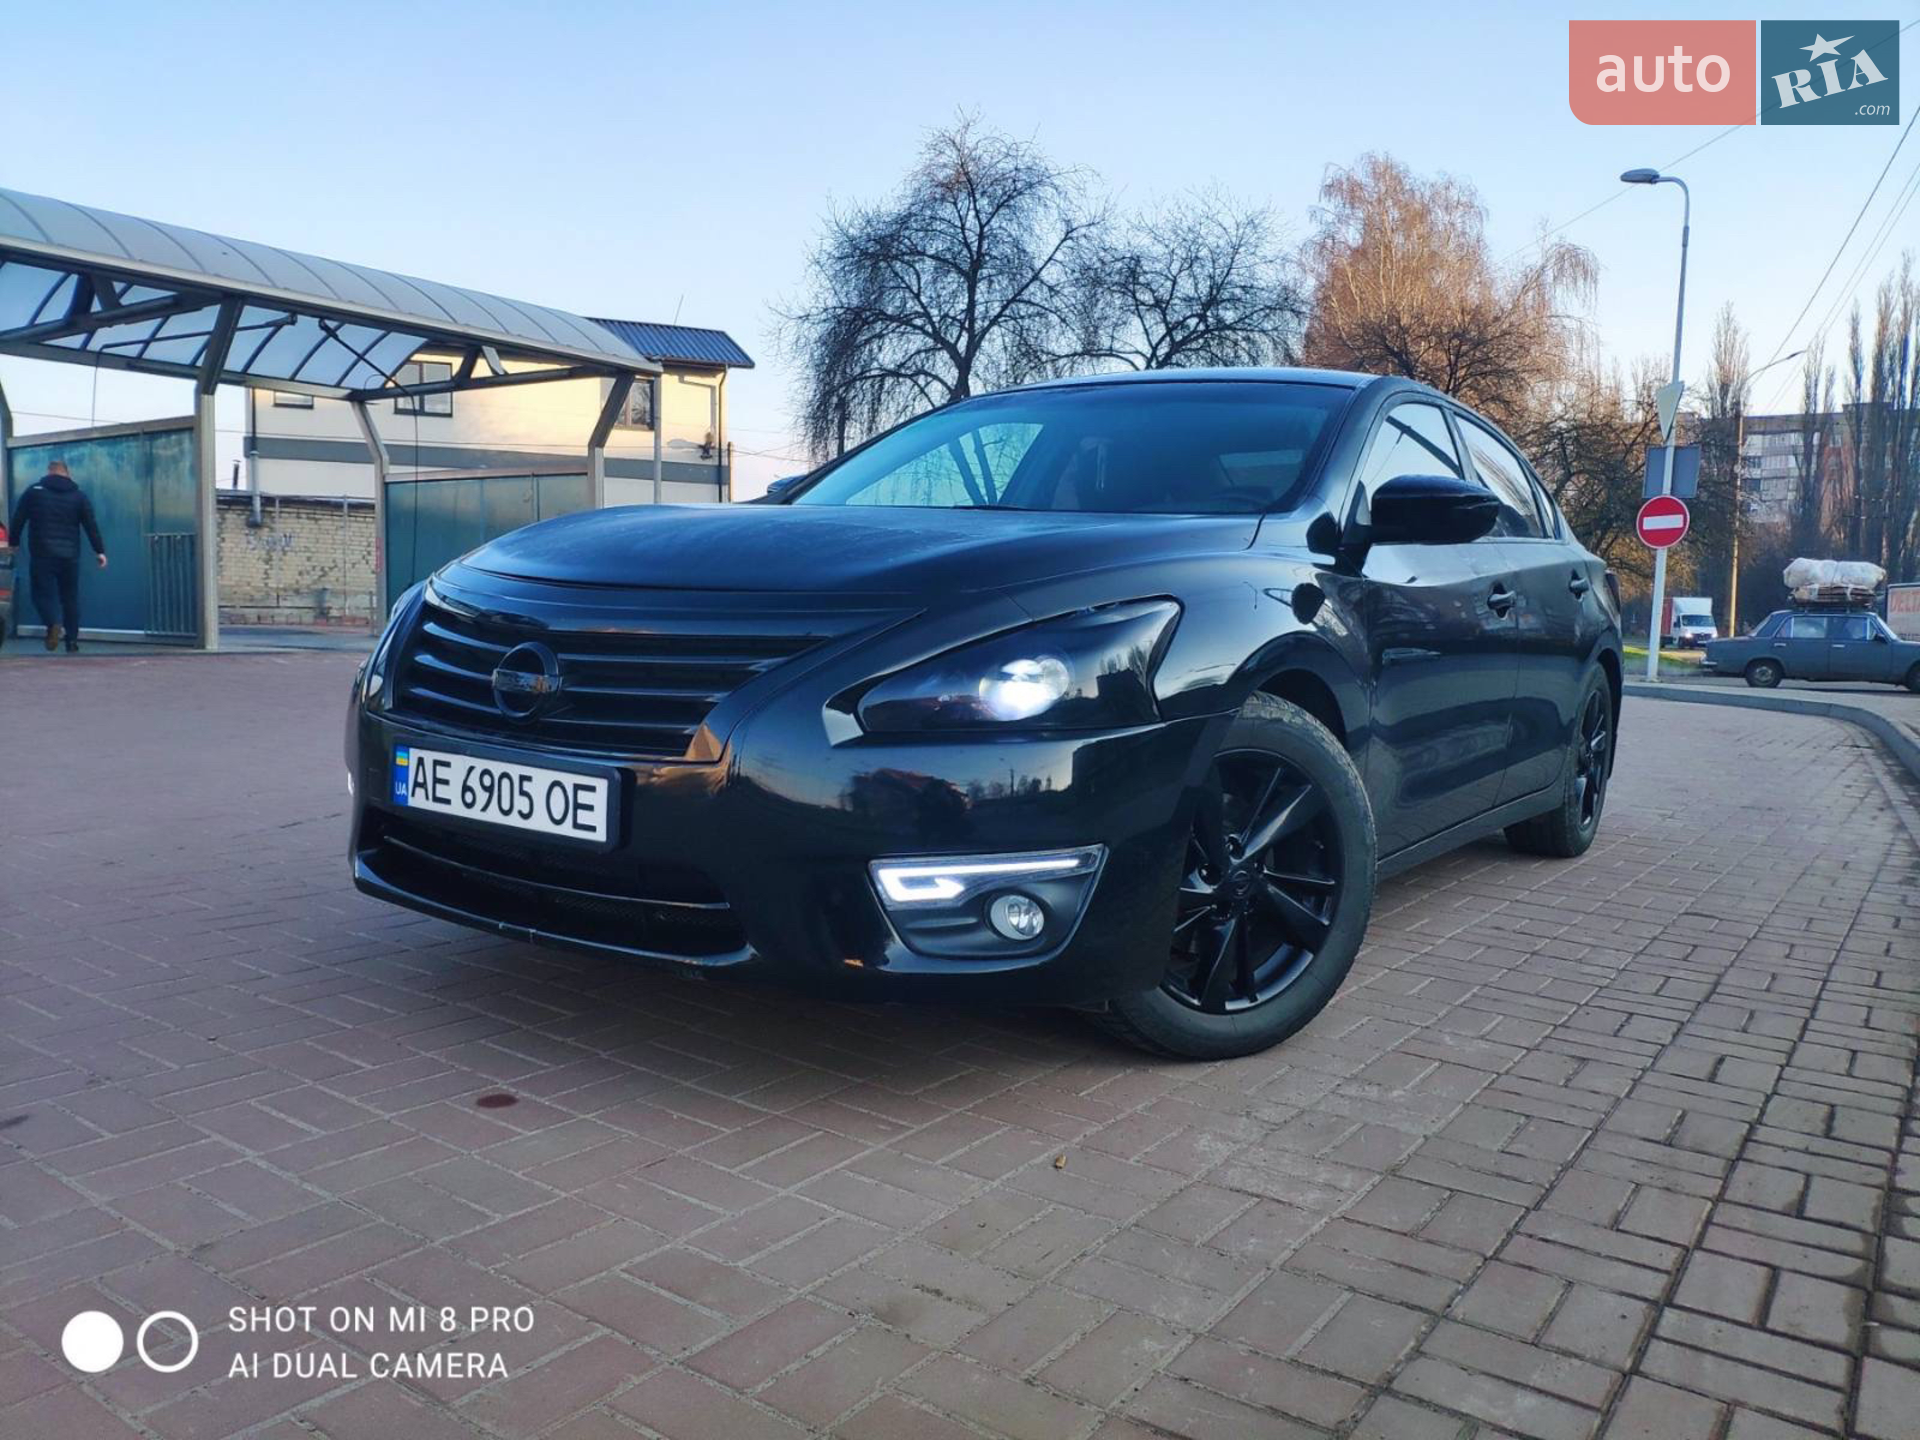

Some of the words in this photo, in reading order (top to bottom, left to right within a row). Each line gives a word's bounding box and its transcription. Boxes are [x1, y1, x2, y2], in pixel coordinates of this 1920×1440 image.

[395, 781, 408, 796] UA
[411, 756, 451, 806] AE
[461, 765, 535, 820] 6905
[546, 780, 598, 833] OE
